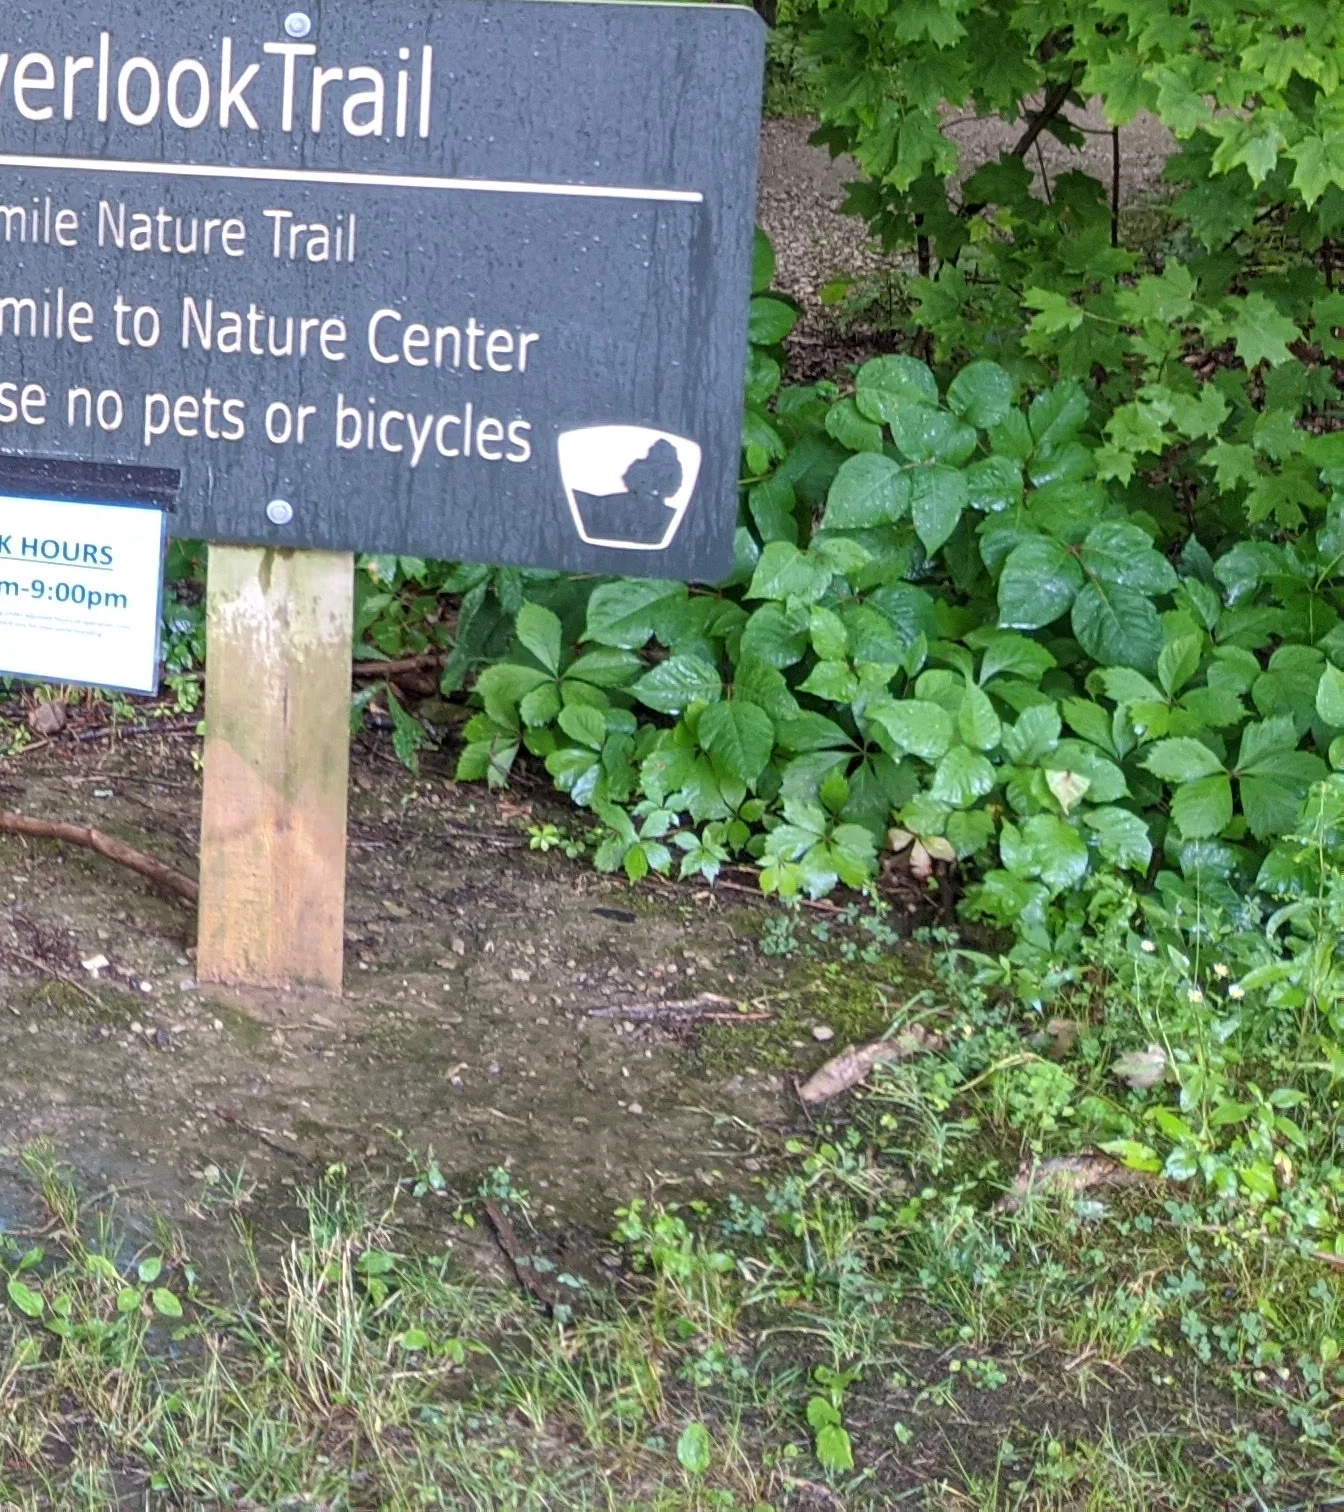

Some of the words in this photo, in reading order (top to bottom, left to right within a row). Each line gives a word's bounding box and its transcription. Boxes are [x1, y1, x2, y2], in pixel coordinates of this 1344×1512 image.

[96, 198, 248, 258] Nature
[261, 207, 357, 265] Trail
[113, 293, 161, 349] to
[180, 294, 349, 364] Nature
[366, 306, 542, 375] Center
[66, 383, 125, 432] no
[142, 386, 247, 448] pets
[263, 399, 319, 445] or
[334, 391, 533, 468] bicycles
[21, 537, 114, 565] HOURS
